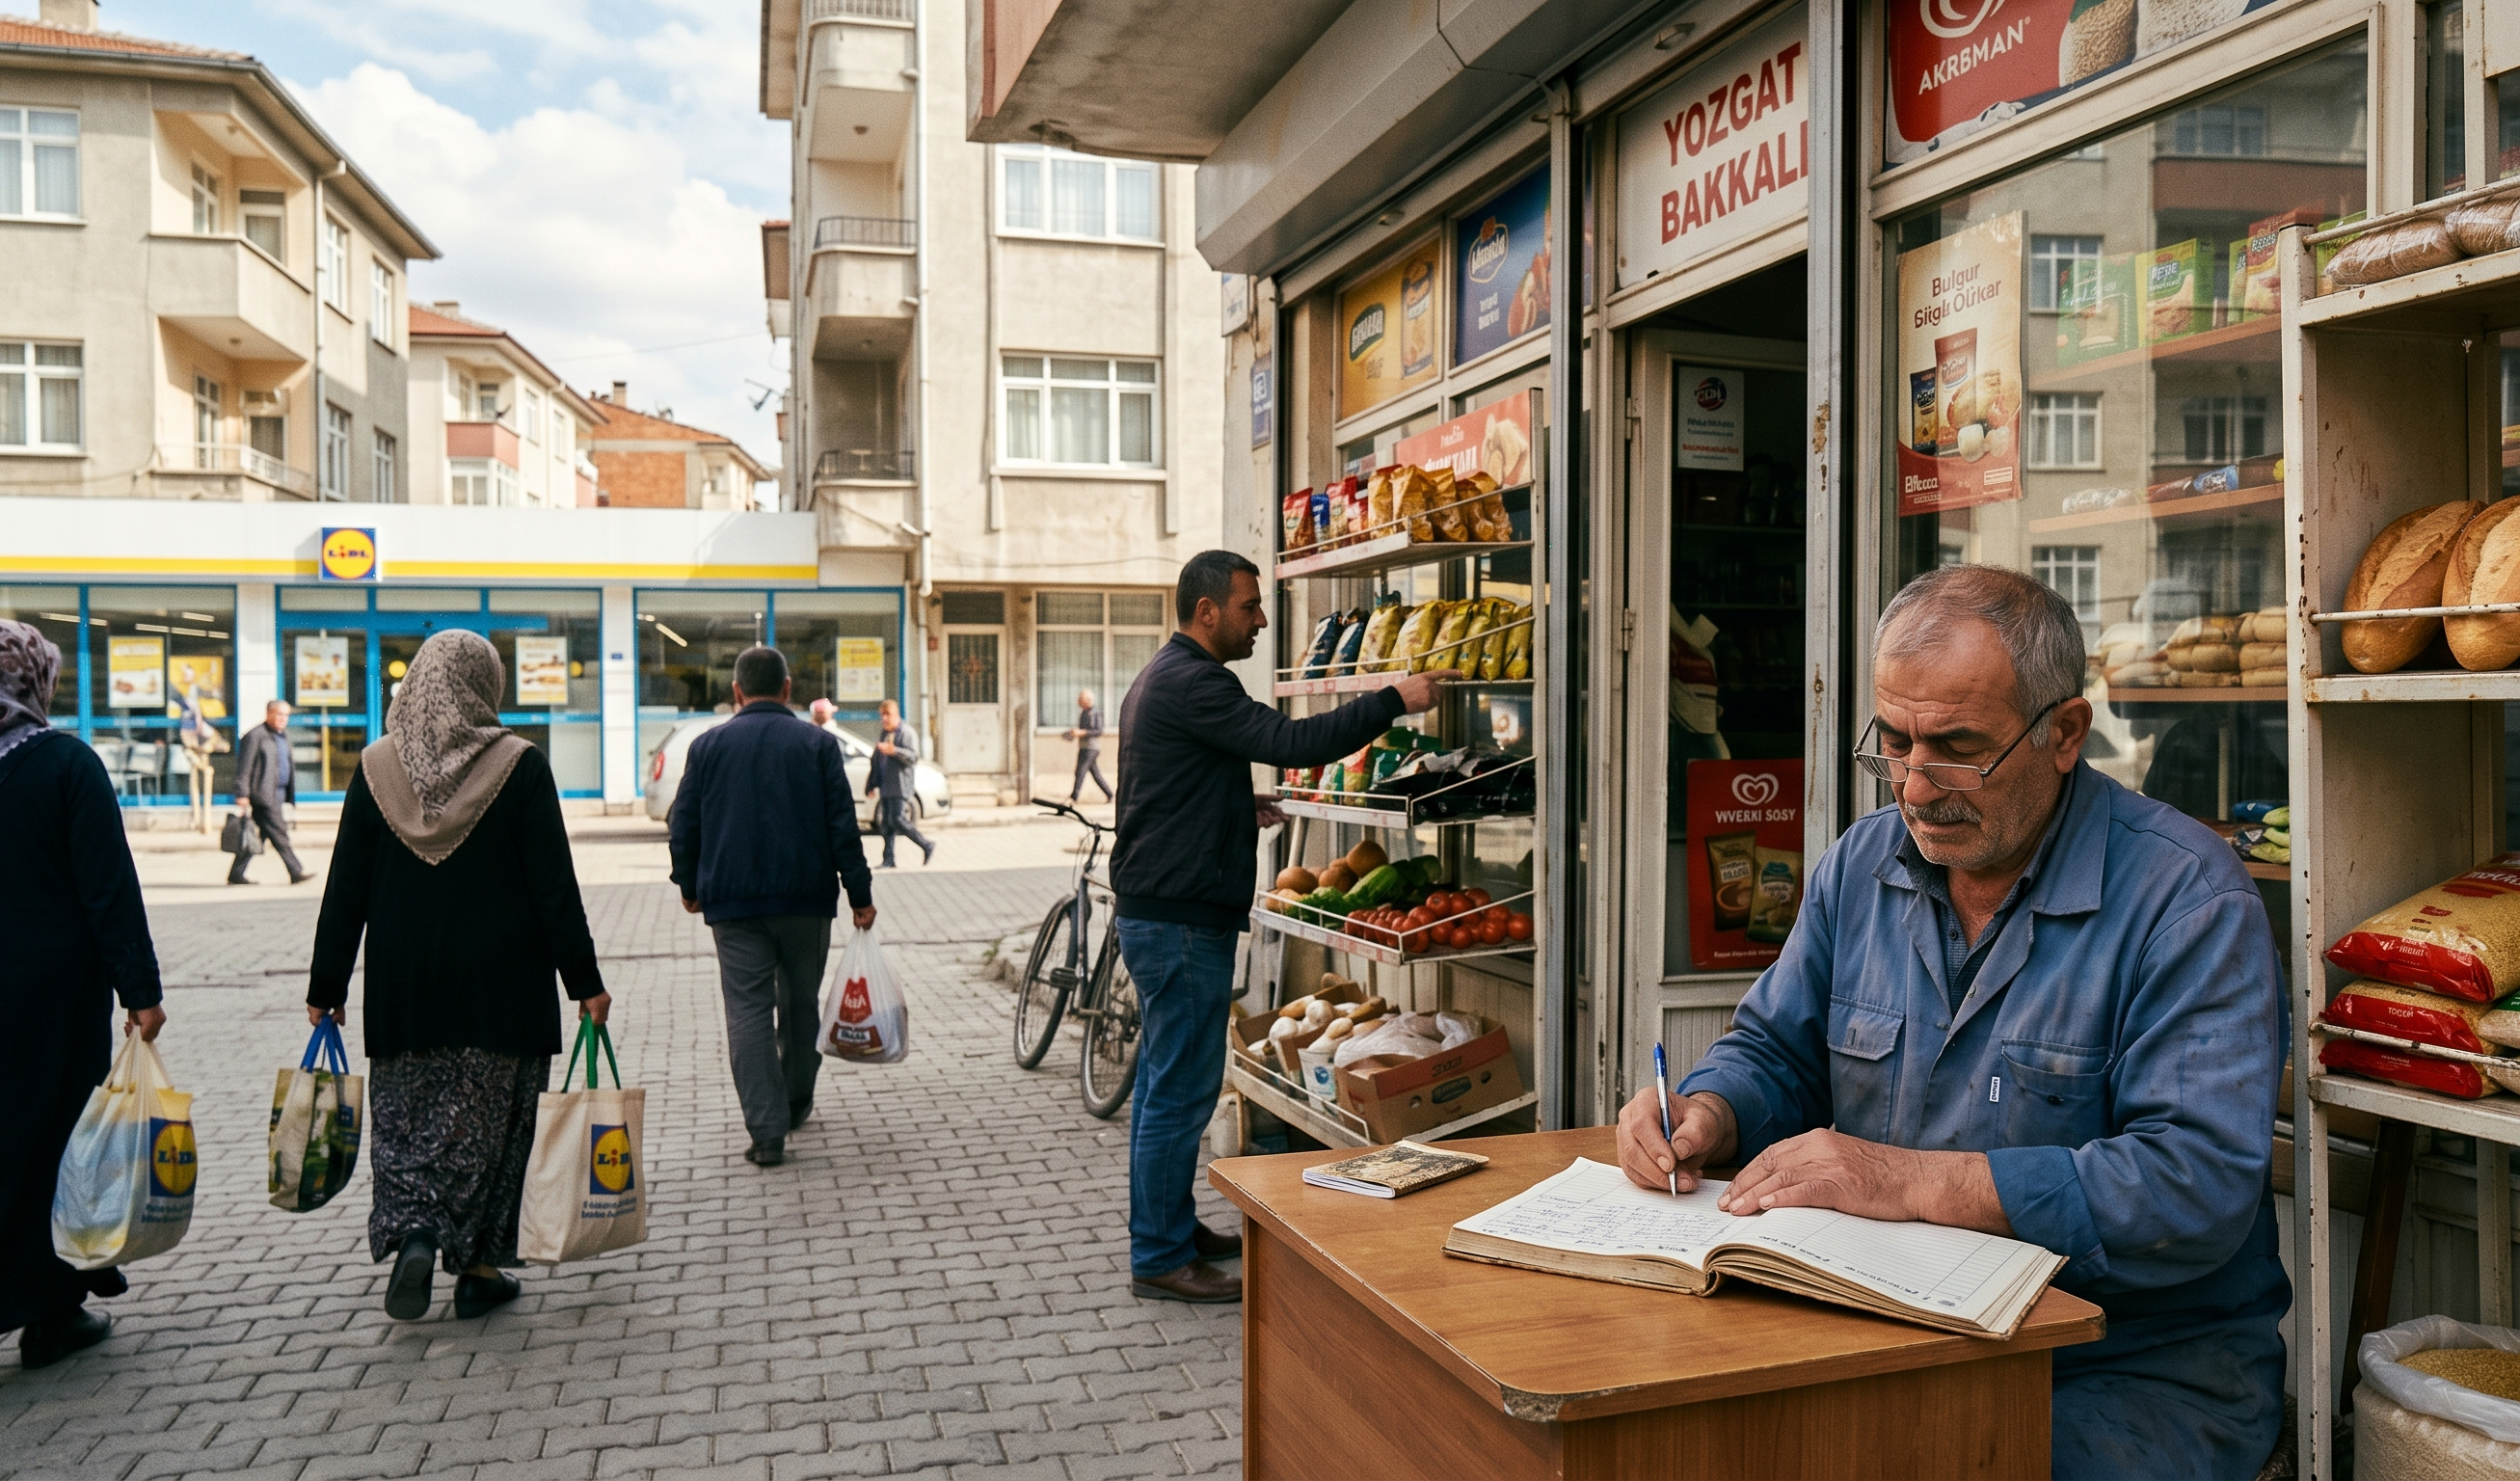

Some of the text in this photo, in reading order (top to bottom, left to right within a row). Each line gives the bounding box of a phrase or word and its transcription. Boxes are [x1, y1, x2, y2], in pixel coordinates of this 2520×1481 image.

[1918, 18, 2024, 95] AKRBMAN
[1663, 41, 1801, 168] YOZGAT
[1932, 262, 1980, 298] Bulgur
[1765, 808, 1797, 821] SOSY
